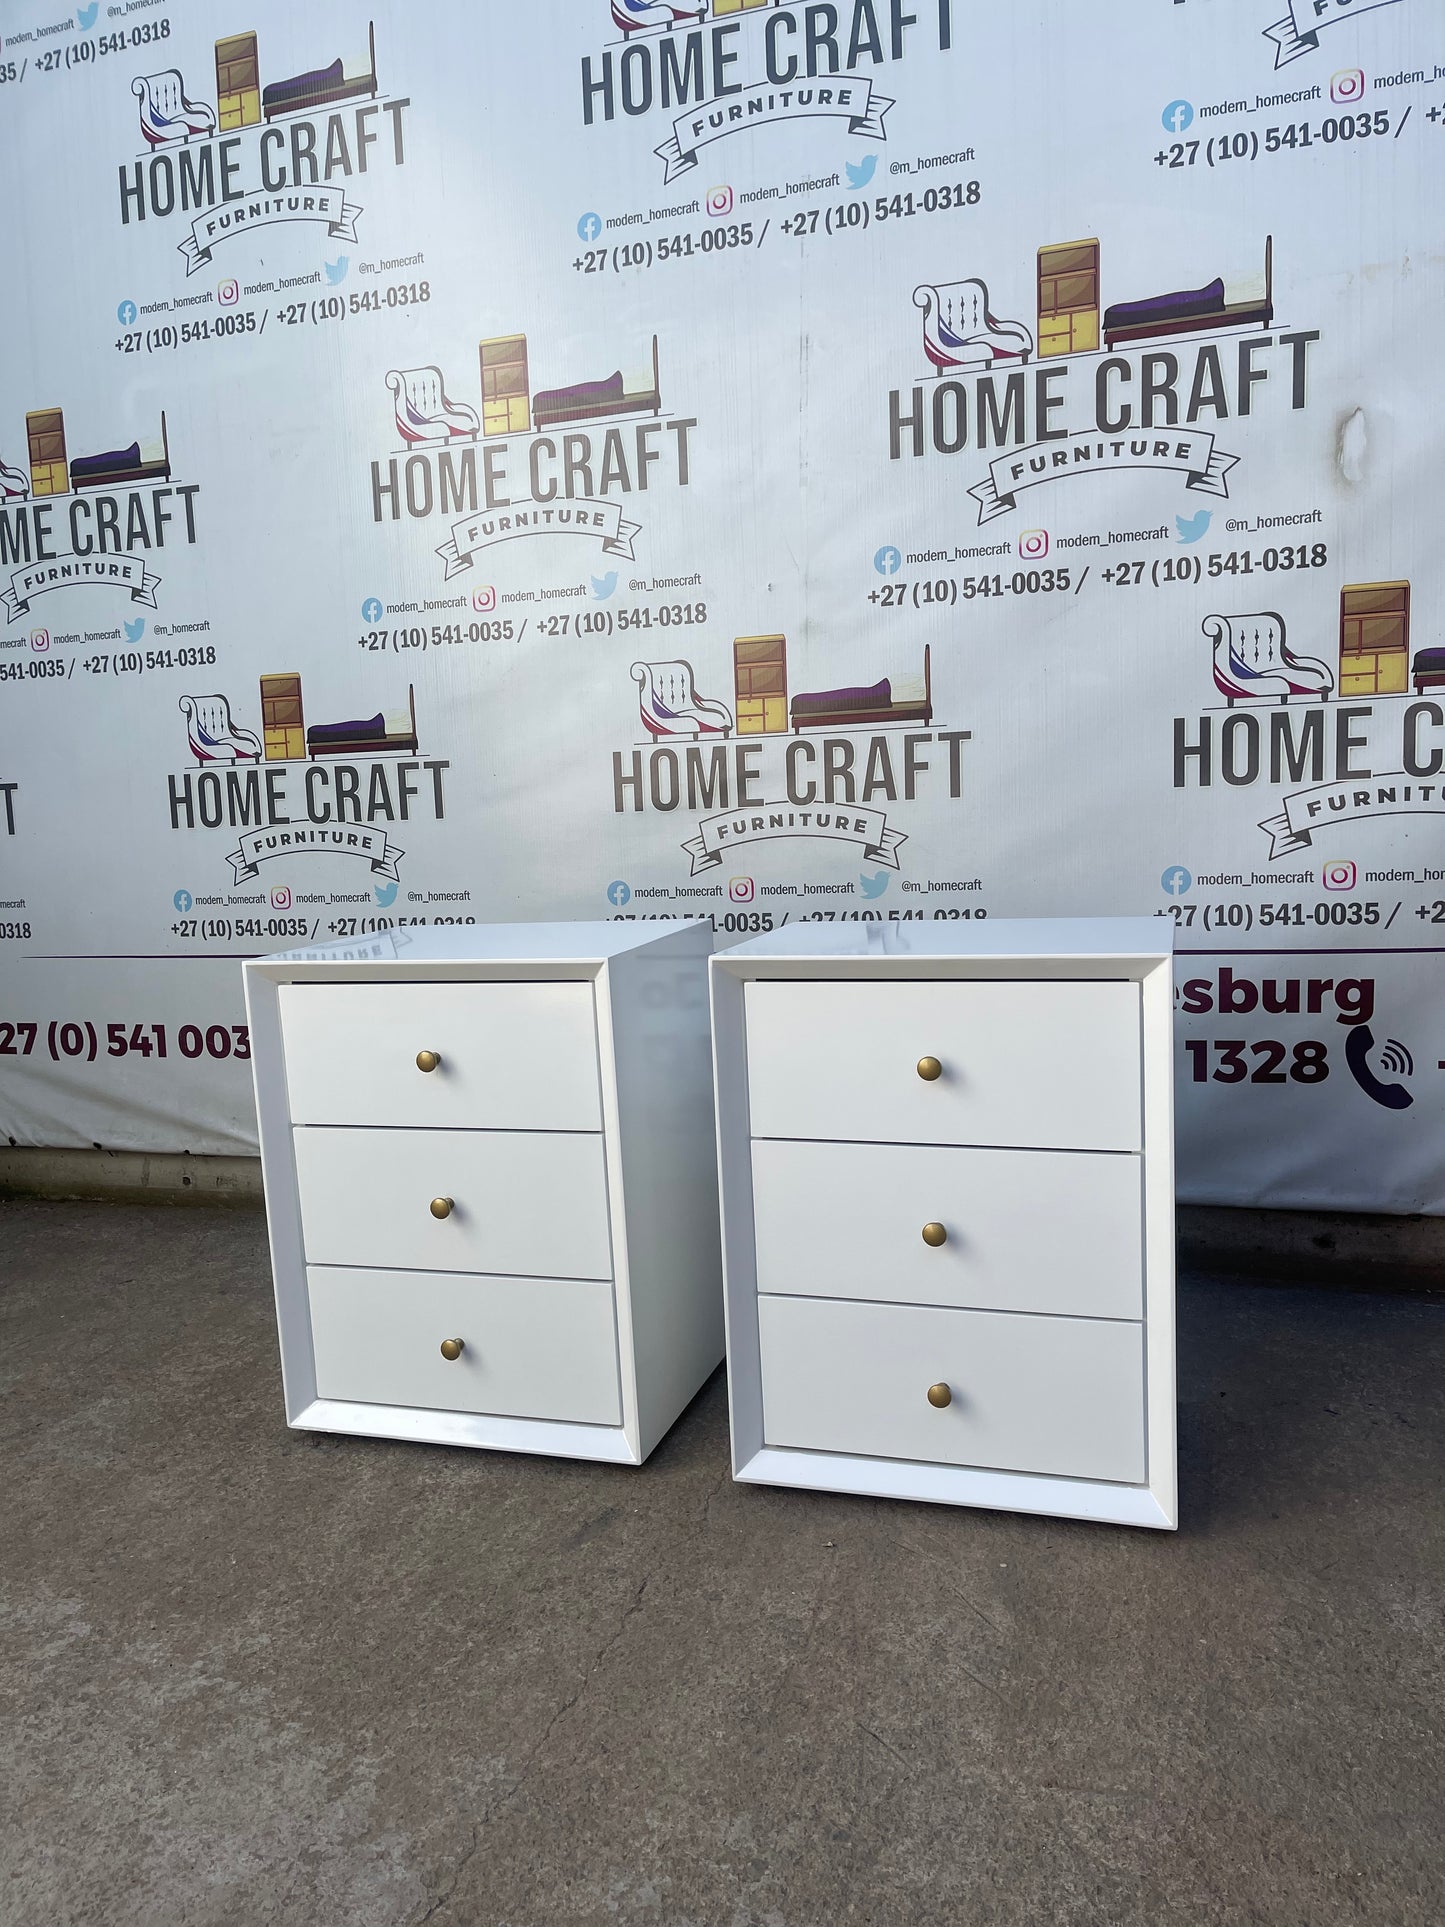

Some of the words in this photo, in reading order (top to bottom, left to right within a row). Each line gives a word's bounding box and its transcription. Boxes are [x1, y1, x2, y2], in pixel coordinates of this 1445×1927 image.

[35, 49, 62, 72] +27
[65, 40, 96, 70] (10)
[99, 18, 171, 56] 541-0318
[581, 22, 743, 126] HOME
[692, 89, 852, 138] FURNITURE
[1154, 140, 1200, 169] +27
[1206, 131, 1258, 167] (10)
[1265, 109, 1389, 153] 541-0035
[118, 137, 246, 225] HOME
[260, 97, 410, 193] CRAFT
[206, 197, 329, 236] FURNITURE
[572, 249, 608, 274] +27
[613, 241, 653, 273] (10)
[657, 222, 753, 260] 541-0035
[780, 209, 820, 236] +27
[825, 201, 870, 235] (10)
[875, 180, 981, 221] 541-0318
[115, 332, 142, 353] +27
[146, 326, 178, 353] (10)
[181, 311, 256, 343] 541-0035
[276, 302, 307, 325] +27
[311, 296, 345, 325] (10)
[349, 281, 430, 314] 541-0318
[889, 366, 1068, 460] HOME
[1095, 330, 1320, 434] CRAFT
[371, 443, 510, 522] HOME
[529, 417, 697, 503] CRAFT
[1010, 440, 1192, 481] FURNITURE
[69, 484, 200, 557] CRAFT
[468, 509, 605, 542] FURNITURE
[24, 563, 132, 590] FURNITURE
[867, 583, 907, 607] +27
[913, 579, 957, 609] (10)
[962, 568, 1071, 599] 541-0035
[1101, 561, 1146, 586] +27
[1151, 556, 1201, 588] (10)
[1207, 543, 1327, 577] 541-0318
[358, 631, 388, 651] +27
[393, 627, 427, 653] (10)
[431, 620, 514, 646] 541-0035
[537, 614, 570, 636] +27
[575, 611, 613, 638] (10)
[617, 602, 707, 630] 541-0318
[83, 655, 109, 674] +27
[113, 652, 143, 676] (10)
[146, 646, 216, 669] 541-0318
[612, 743, 764, 813] HOME
[786, 730, 972, 806] CRAFT
[1173, 706, 1372, 788] HOME
[168, 768, 290, 829] HOME
[305, 760, 450, 824] CRAFT
[1306, 786, 1445, 818] FURNIT
[253, 830, 372, 853] FURNITURE
[717, 813, 867, 840] FURNITURE
[171, 920, 197, 937] +27
[201, 919, 232, 941] (10)
[235, 918, 308, 937] 541-0035
[328, 918, 357, 936] +27
[1203, 904, 1253, 932] (10)
[1259, 902, 1380, 926] 541-0035
[1173, 967, 1375, 1026] sburg
[48, 1021, 97, 1062] (0)
[107, 1023, 167, 1058] 541
[1185, 1040, 1329, 1084] 1328
